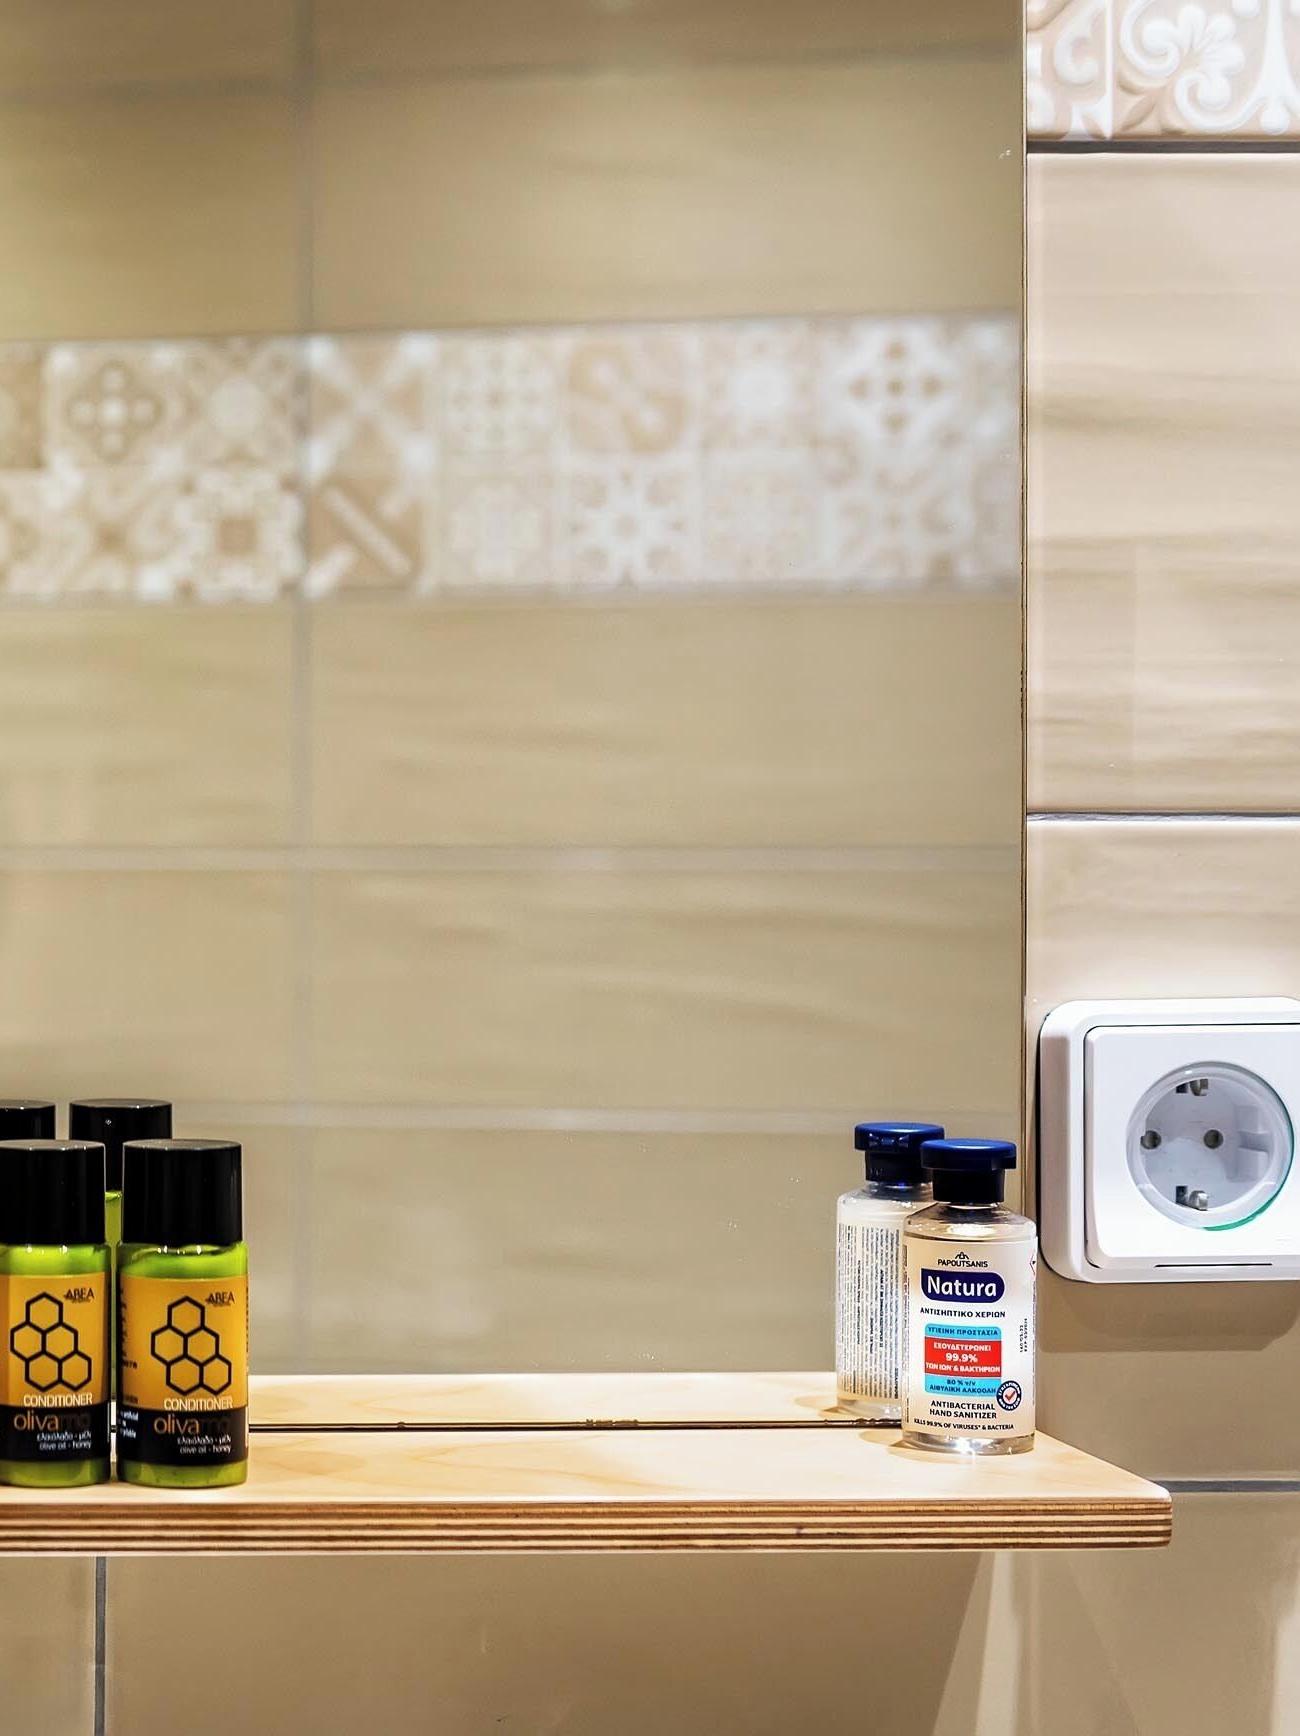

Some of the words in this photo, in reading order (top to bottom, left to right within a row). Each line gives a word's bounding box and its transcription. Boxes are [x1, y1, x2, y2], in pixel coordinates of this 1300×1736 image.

[937, 1259, 988, 1268] PAPOUTSANIS
[927, 1275, 997, 1297] Natura
[920, 1307, 973, 1317] ΑΝΤΙΣΗΠΤΙΚΟ
[957, 1328, 998, 1336] ΠΡΟΣΤΑΣΙΑ
[945, 1353, 978, 1363] 99.9%
[24, 1392, 93, 1407] CONDITIONER
[164, 1397, 233, 1411] CONDITIONER
[931, 1400, 995, 1410] ANTIBACTERIAL
[929, 1409, 952, 1417] HAND
[953, 1411, 997, 1419] SANITIZER
[926, 1420, 943, 1428] 99.9%
[39, 1442, 56, 1450] olive
[73, 1440, 91, 1450] honey
[180, 1445, 197, 1454] olive
[198, 1445, 207, 1453] oil
[213, 1444, 231, 1454] honey
